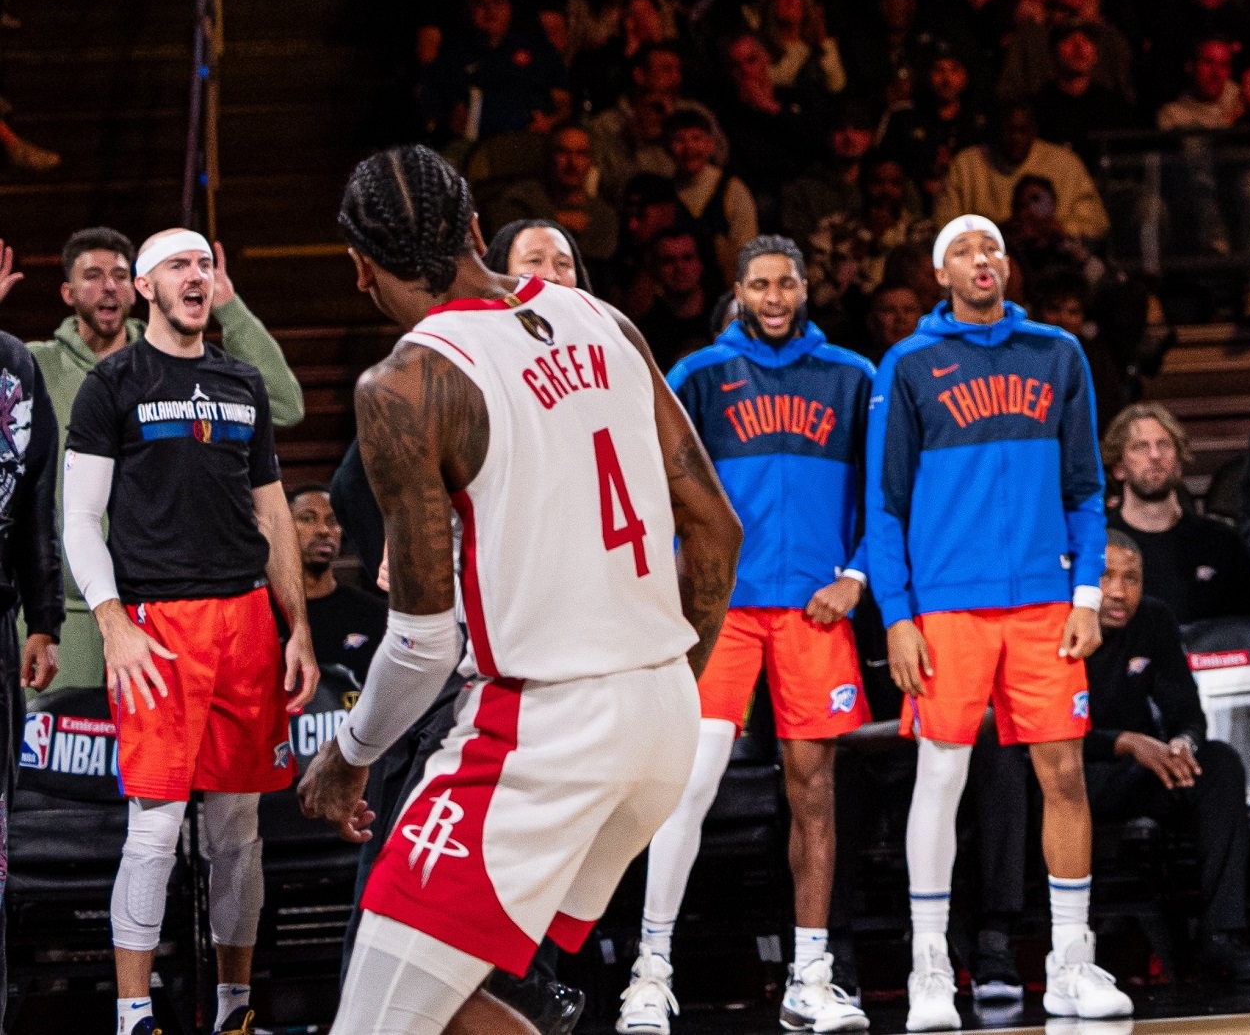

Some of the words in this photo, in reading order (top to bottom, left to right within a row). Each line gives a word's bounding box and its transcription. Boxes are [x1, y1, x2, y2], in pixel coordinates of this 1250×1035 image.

[522, 344, 610, 410] GREEN
[937, 374, 1054, 429] THUNDER
[137, 400, 196, 423] OKLAHOMA
[195, 400, 219, 421] CITY
[723, 394, 837, 446] THUNDER
[592, 426, 650, 578] 4
[50, 731, 107, 776] NBA
